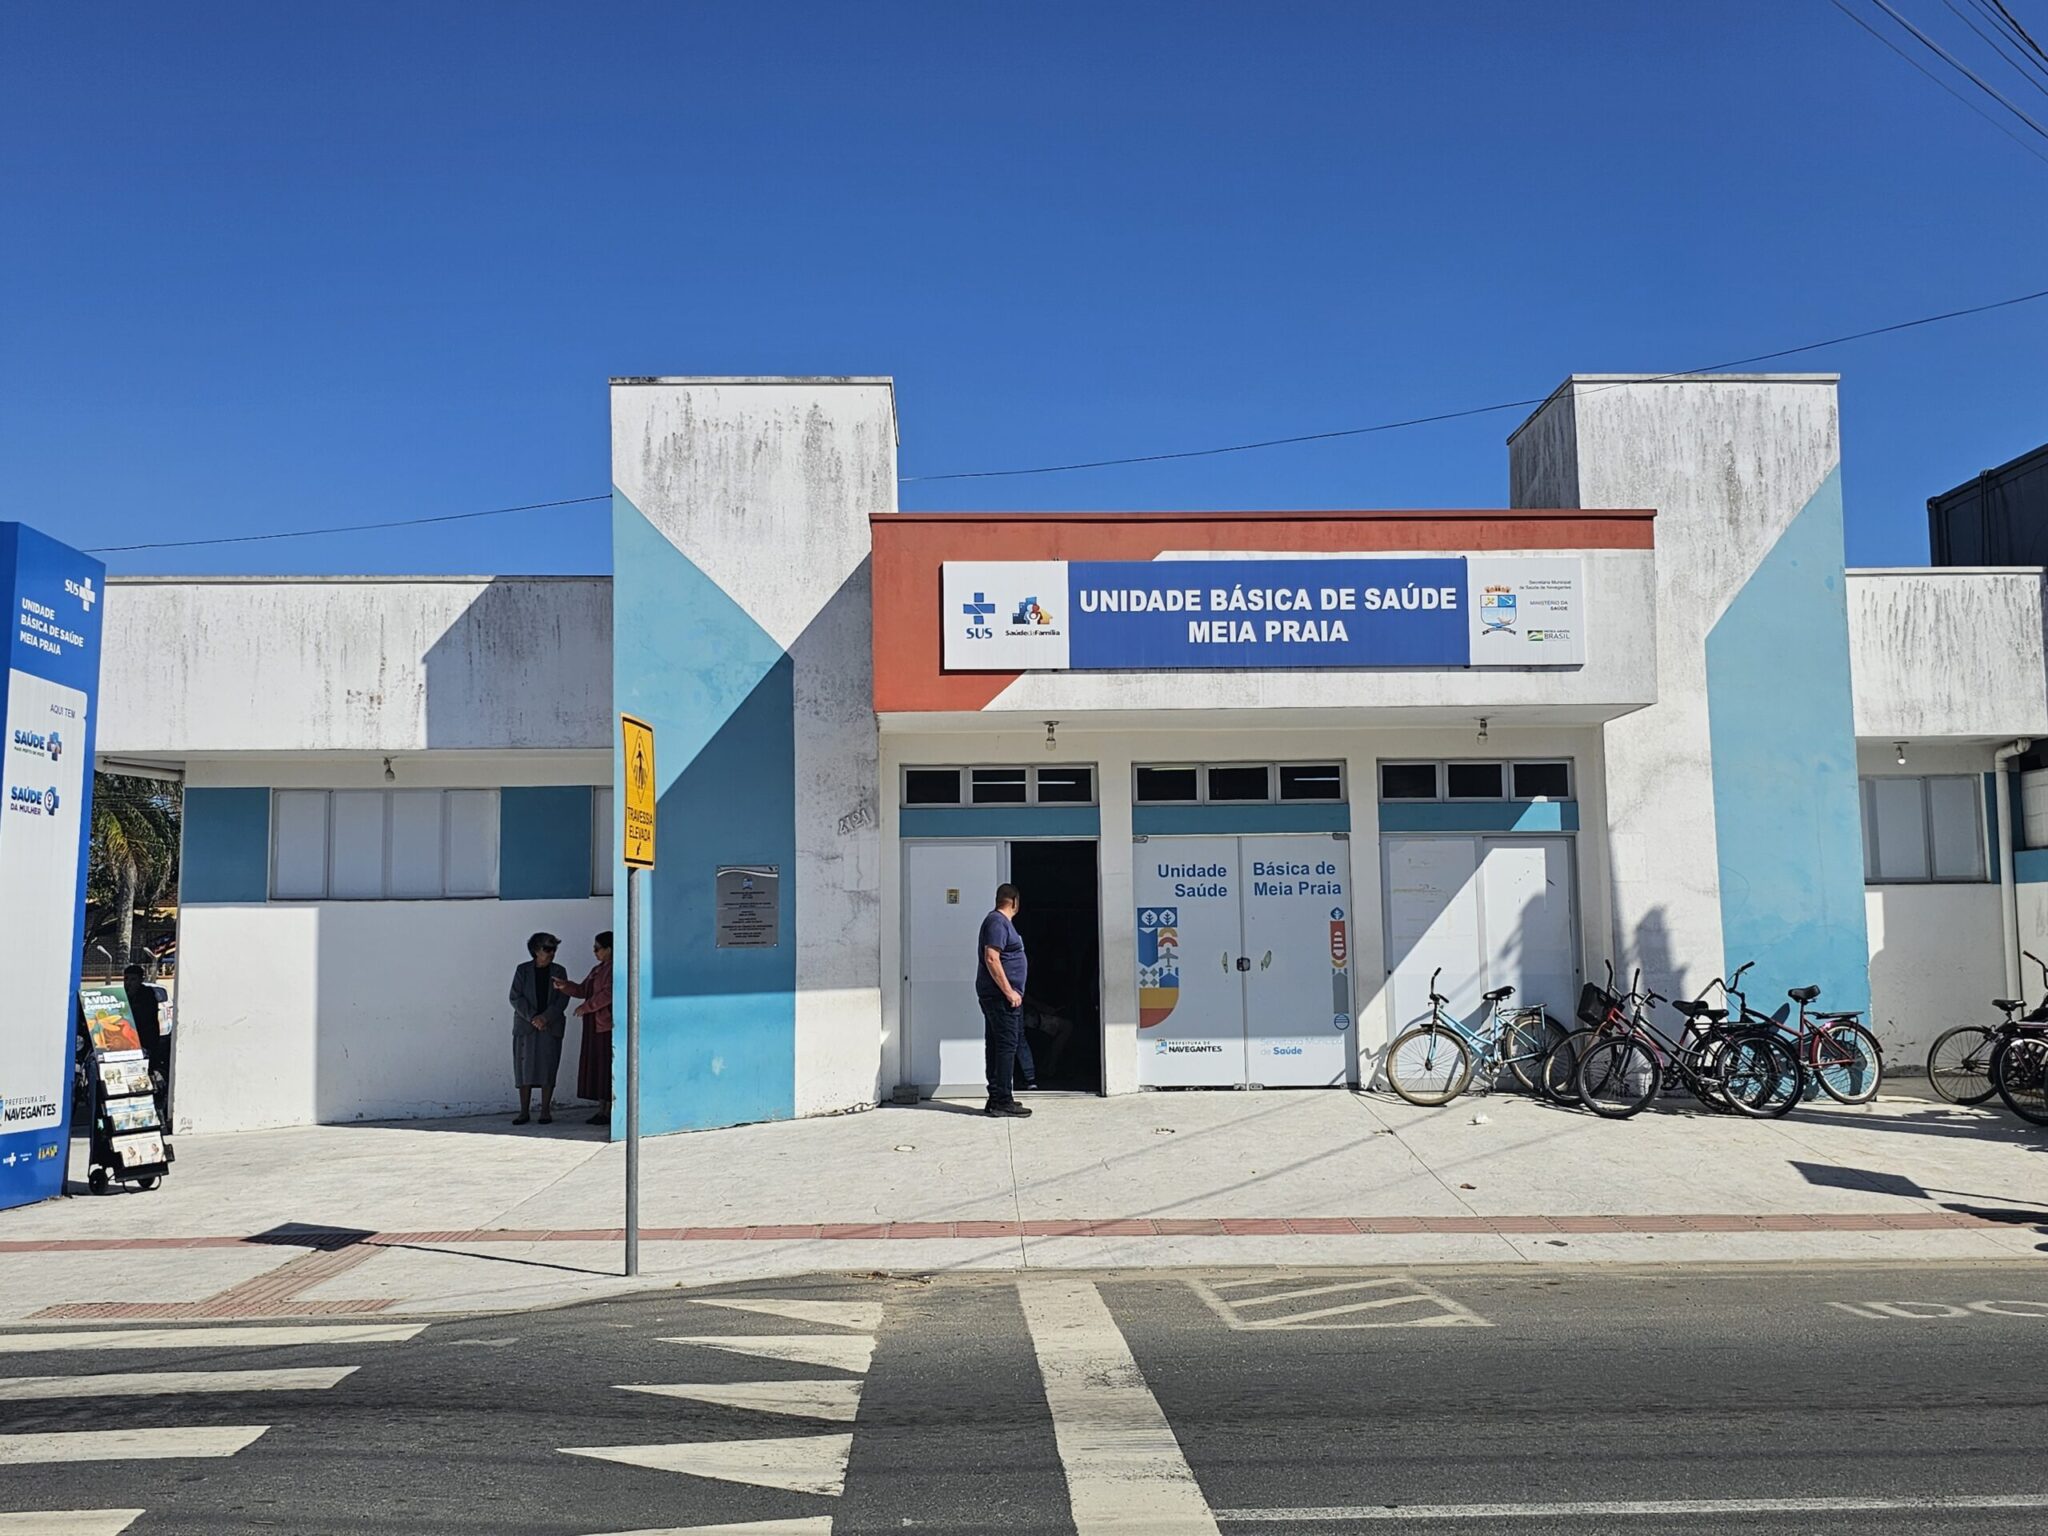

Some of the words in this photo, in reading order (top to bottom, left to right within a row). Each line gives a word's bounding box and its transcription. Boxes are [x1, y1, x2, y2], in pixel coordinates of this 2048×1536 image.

[65, 578, 79, 596] SUS
[1079, 590, 1201, 612] UNIDADE
[1210, 583, 1312, 612] BÁSICA
[1320, 588, 1356, 611] DE
[1364, 583, 1457, 610] SAÚDE
[22, 597, 55, 621] UNIDADE
[21, 613, 48, 634] BÁSICA
[49, 626, 60, 638] DE
[60, 629, 84, 648] SAÚDE
[966, 627, 993, 639] SUS
[1188, 621, 1257, 643] MEIA
[1265, 620, 1349, 642] PRAIA
[20, 630, 38, 648] MEIA
[38, 637, 61, 656] PRAIA
[50, 703, 64, 717] AQUI
[64, 707, 76, 719] TEM
[14, 729, 45, 750] SAÚDE
[11, 786, 42, 805] SAÚDE
[10, 803, 18, 811] DA
[19, 804, 41, 816] MULHER
[627, 806, 652, 825] TRAVESSIA
[629, 825, 651, 841] ELEVADA
[1158, 863, 1227, 878] Unidade
[1253, 861, 1310, 876] Básica
[1315, 861, 1336, 875] de
[1175, 882, 1228, 897] Saúde
[1254, 881, 1293, 896] Meia
[1298, 881, 1342, 895] Praia
[1168, 1045, 1223, 1053] NAVEGANTES
[1273, 1046, 1303, 1055] Saúde
[5, 1096, 38, 1105] PREFEITURA
[4, 1103, 56, 1122] NAVEGANTES
